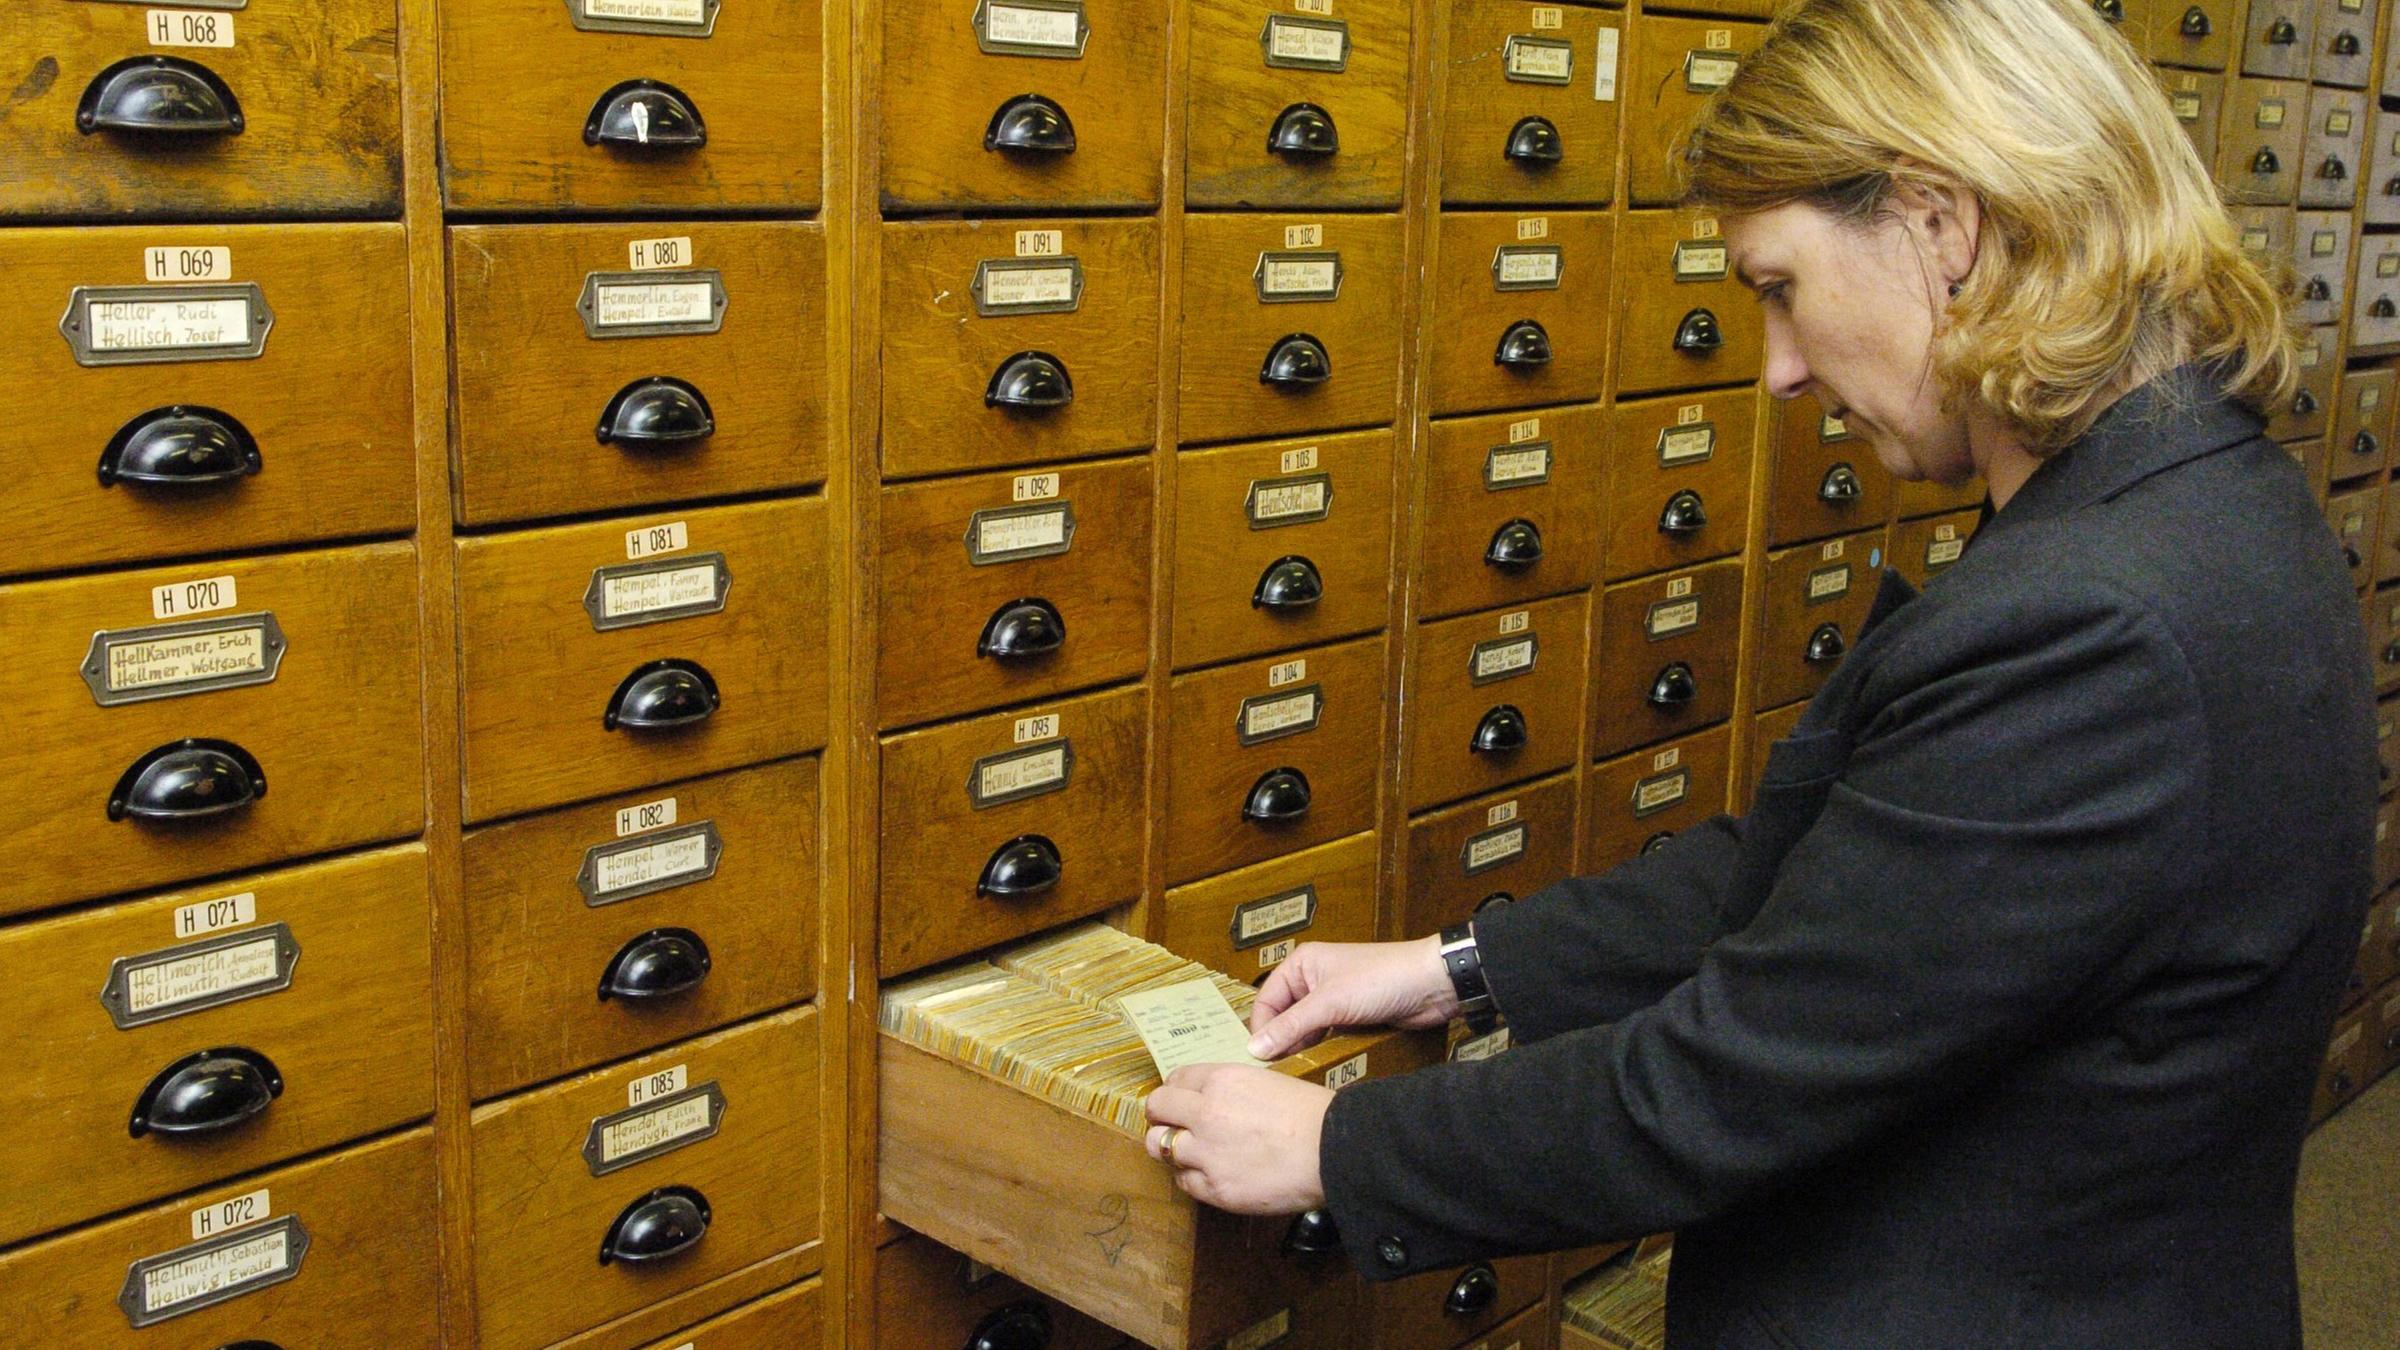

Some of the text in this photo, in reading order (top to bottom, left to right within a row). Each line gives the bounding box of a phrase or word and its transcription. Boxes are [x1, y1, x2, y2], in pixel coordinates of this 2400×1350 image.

[156, 14, 217, 43] H 068
[1020, 233, 1051, 253] H 091
[1288, 227, 1314, 246] H 102
[155, 250, 213, 276] H 069
[635, 241, 678, 266] H 080
[177, 302, 217, 319] Rudi
[1512, 421, 1533, 441] H 114
[1285, 450, 1309, 470] H 103
[1017, 477, 1049, 498] H 092
[631, 527, 674, 555] H 081
[162, 581, 220, 614] H 070
[1511, 613, 1523, 630] 115
[219, 633, 252, 650] Erich
[191, 652, 257, 676] Wolfgang
[1272, 663, 1297, 684] H 104
[1018, 717, 1049, 740] H 093
[622, 804, 663, 833] H 082
[184, 899, 239, 933] H 071
[1262, 942, 1287, 965] H 105
[1328, 1060, 1358, 1089] H 094
[633, 1071, 674, 1103] H 083
[201, 1197, 254, 1235] H 072
[232, 1235, 284, 1264] Sebastian
[229, 1257, 273, 1283] Ewald
